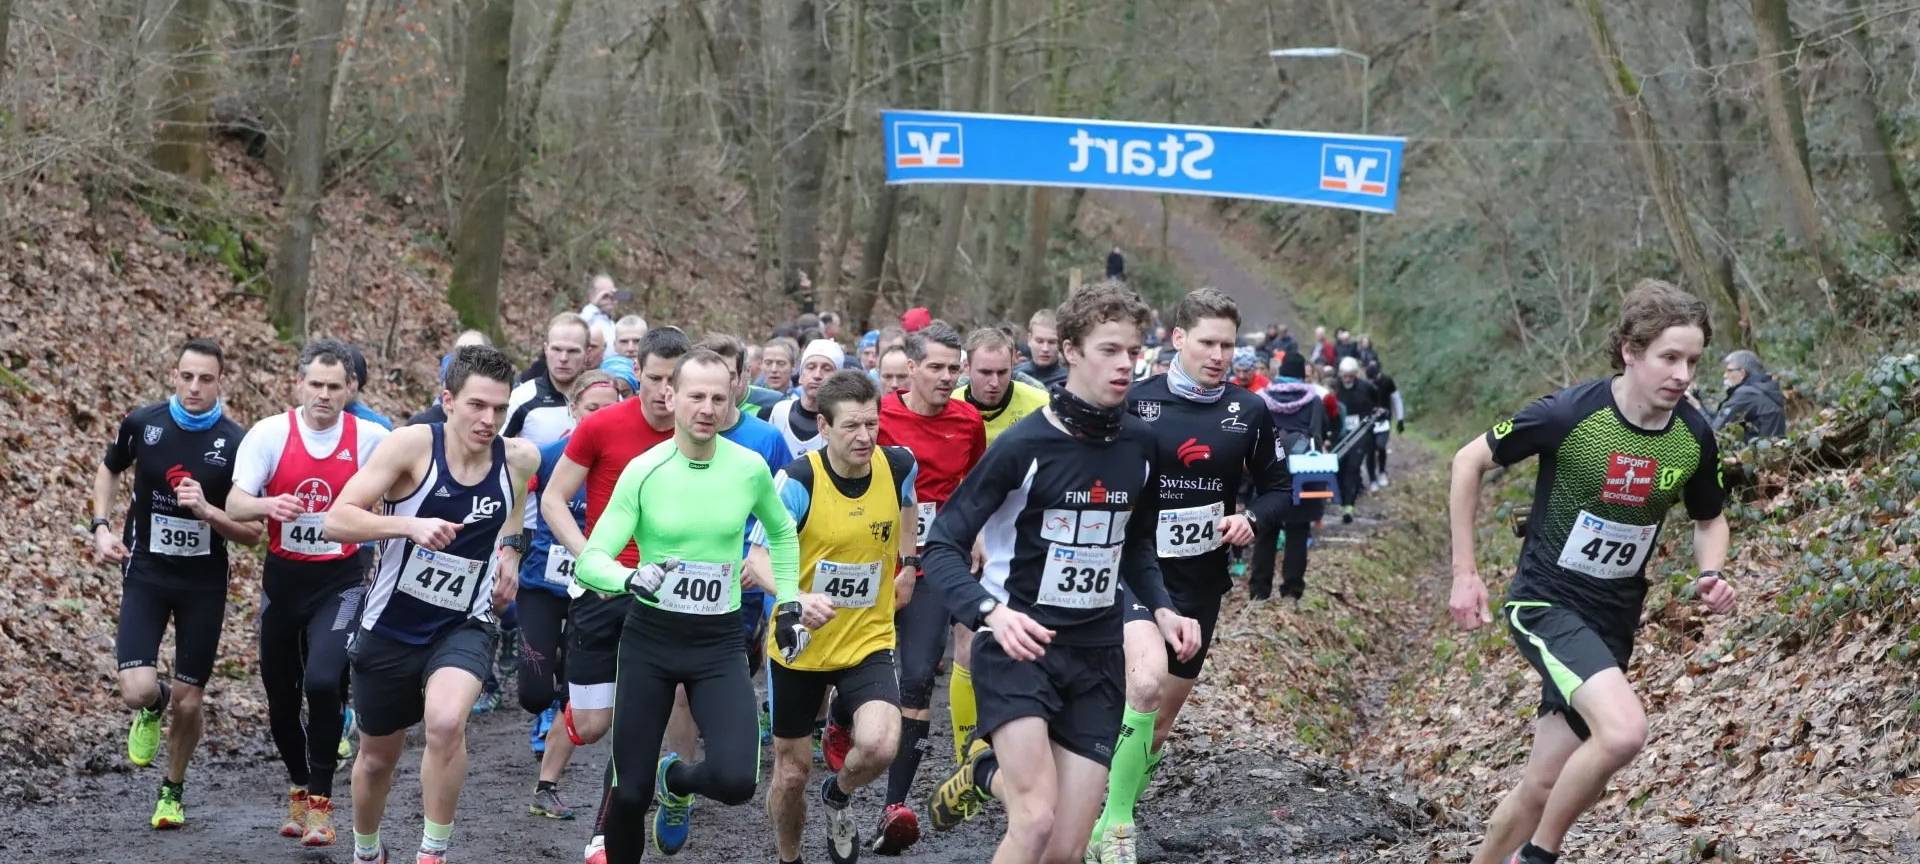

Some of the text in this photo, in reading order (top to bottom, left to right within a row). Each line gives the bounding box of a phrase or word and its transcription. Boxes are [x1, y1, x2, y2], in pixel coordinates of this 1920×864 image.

[1616, 455, 1651, 468] SPORT
[1159, 475, 1223, 492] SwissLife
[297, 492, 329, 503] BAYER
[1065, 486, 1128, 504] FINISHER
[1160, 489, 1184, 500] Select
[160, 528, 200, 548] 395
[1170, 520, 1214, 546] 324
[1581, 537, 1637, 566] 479
[415, 566, 465, 597] 474
[672, 577, 722, 602] 400
[824, 577, 869, 598] 454
[1058, 566, 1111, 594] 336
